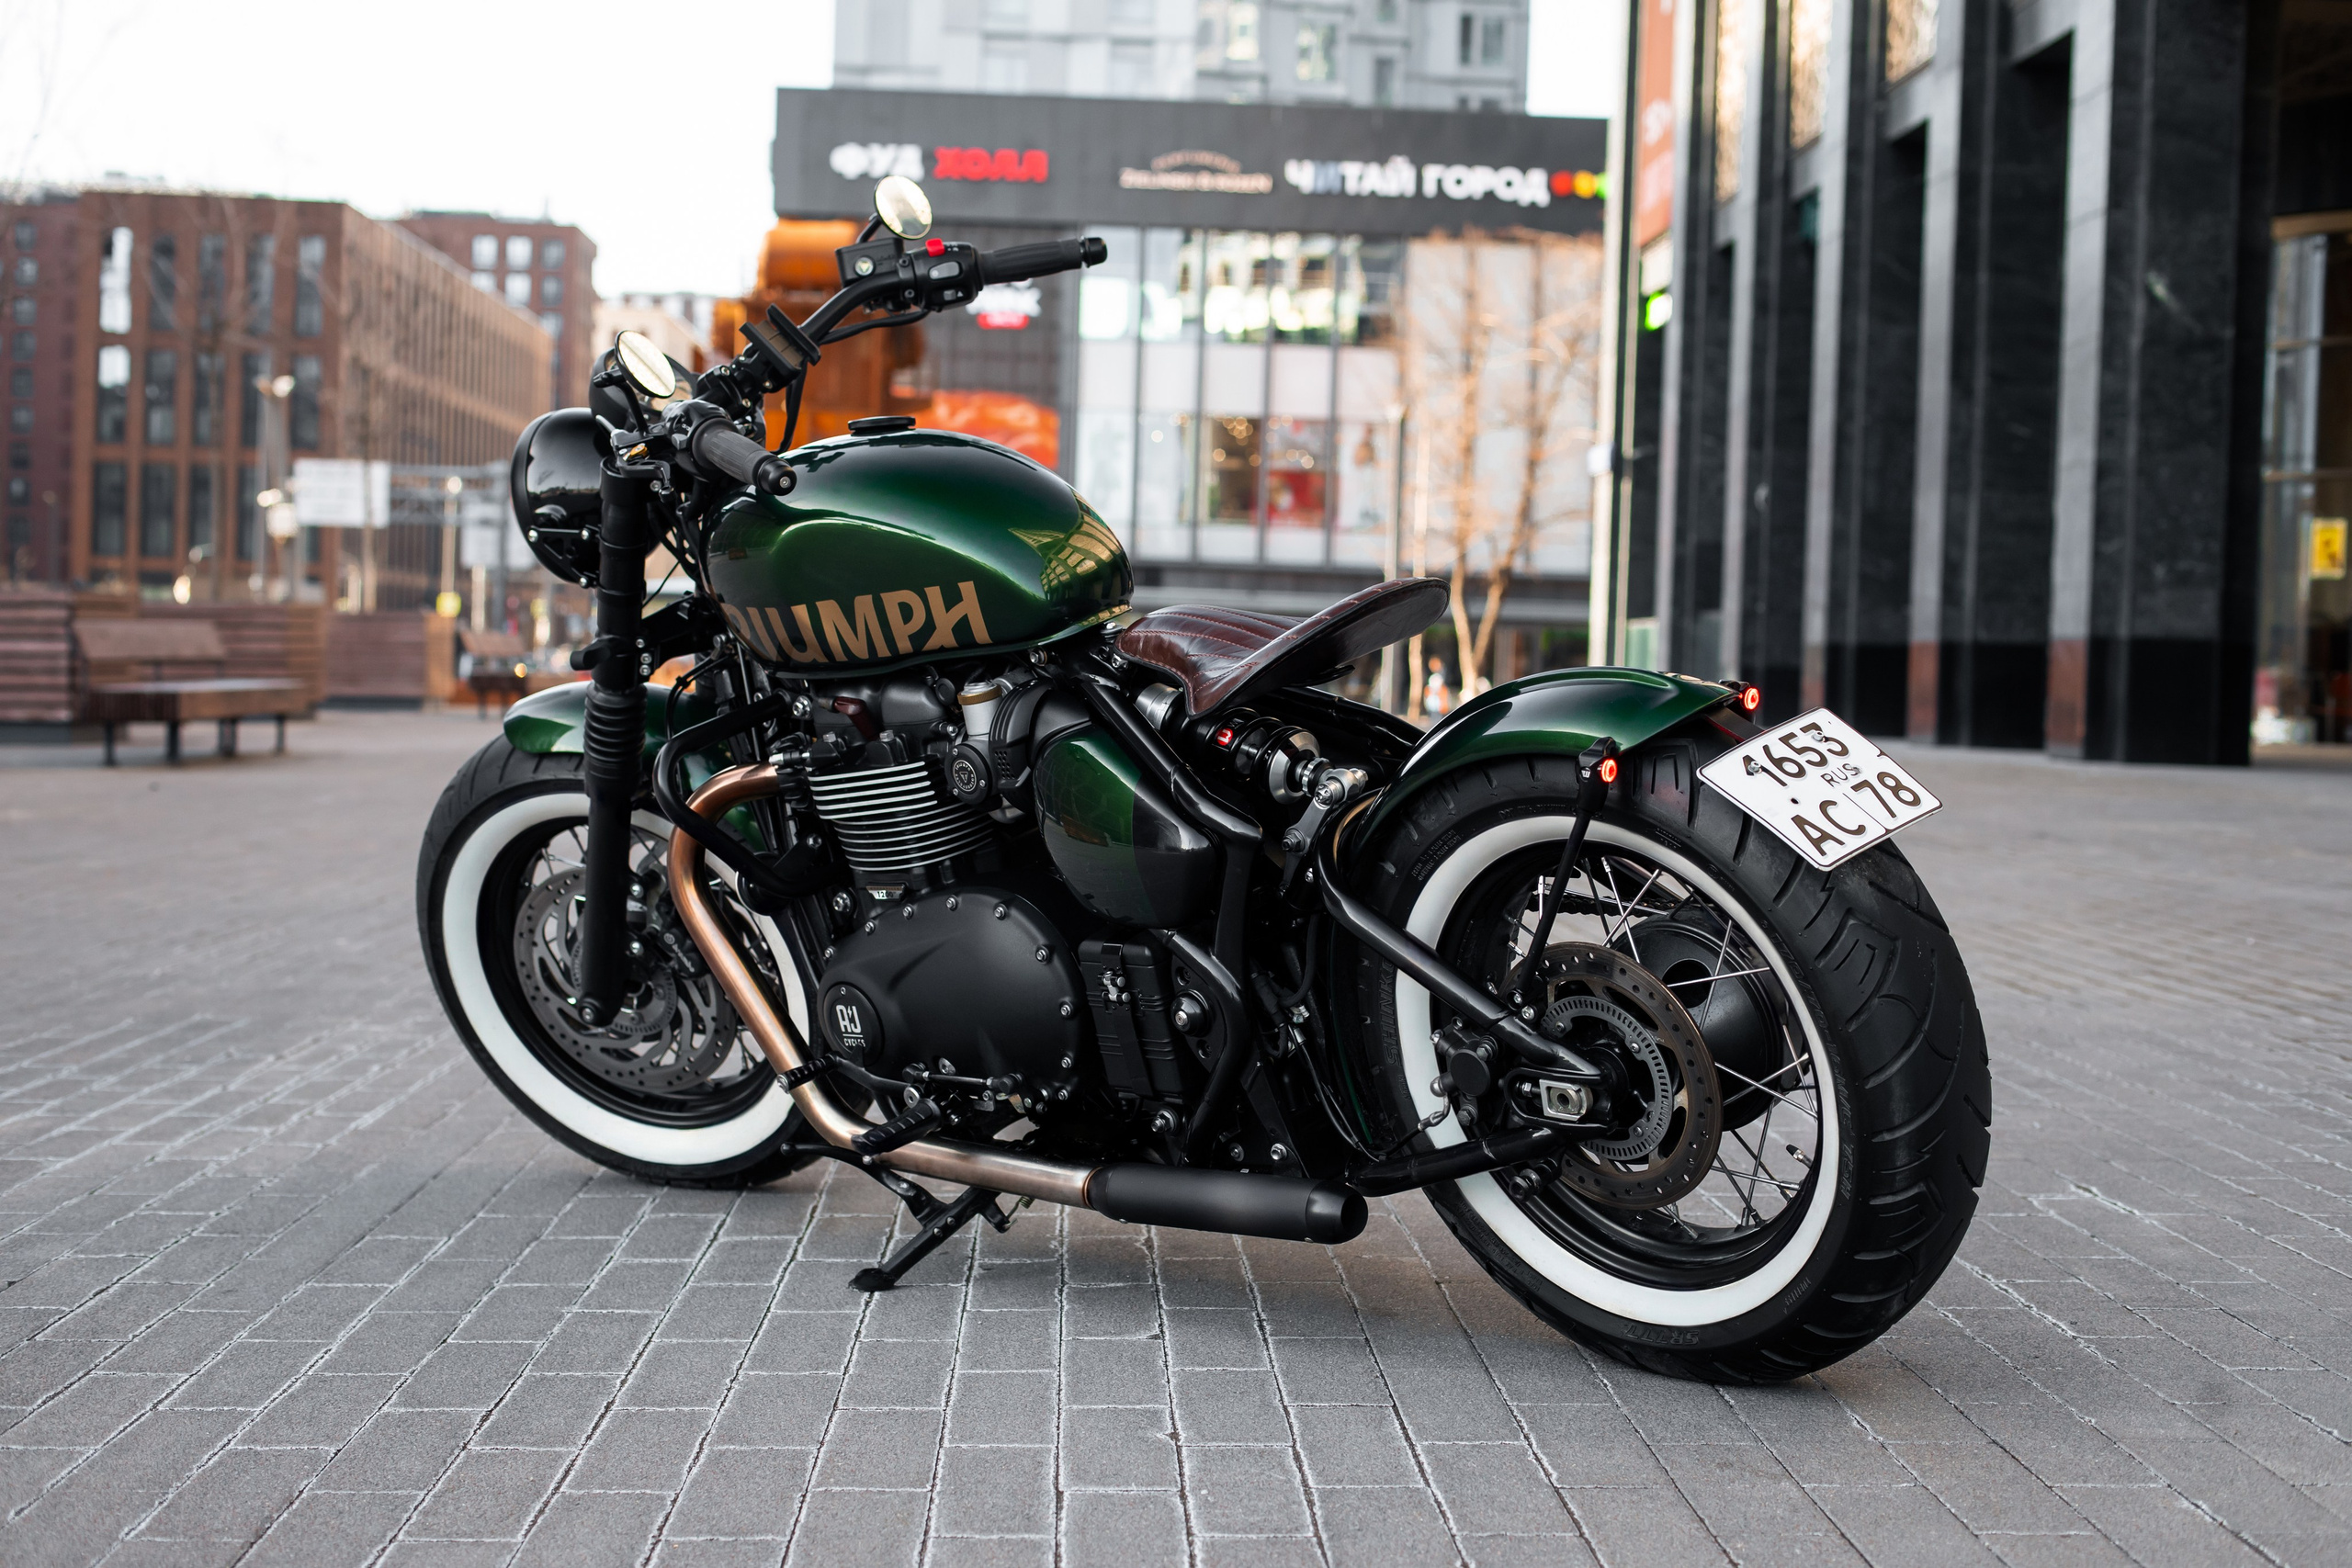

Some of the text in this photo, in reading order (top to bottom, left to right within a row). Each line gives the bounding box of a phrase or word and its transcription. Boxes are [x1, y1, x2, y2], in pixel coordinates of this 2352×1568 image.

[933, 147, 1049, 183] ХОЛЛ
[1284, 154, 1417, 197] ЧИТАЙ
[1422, 163, 1551, 208] ГОРОД
[1820, 762, 1863, 788] RUS
[1850, 771, 1921, 819] 78
